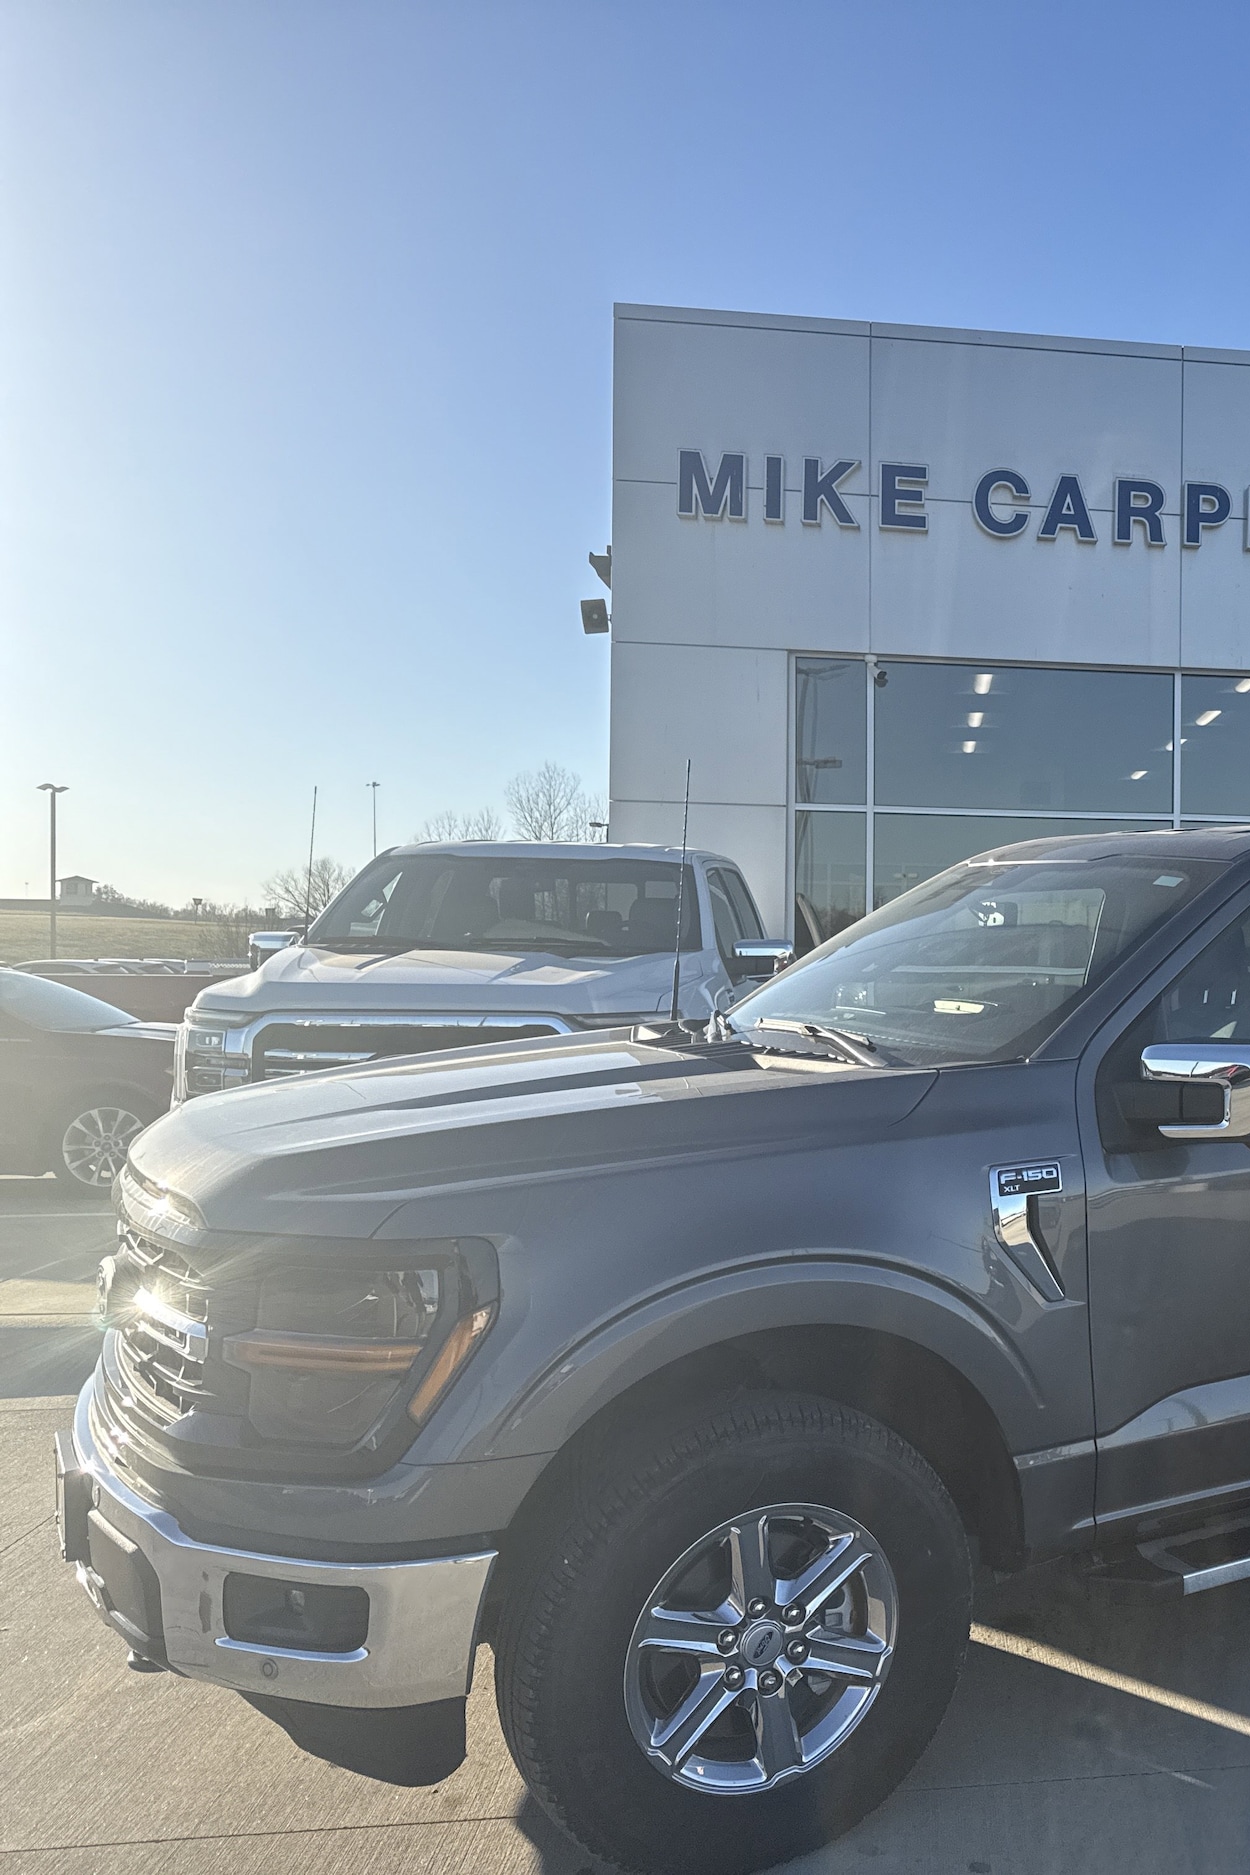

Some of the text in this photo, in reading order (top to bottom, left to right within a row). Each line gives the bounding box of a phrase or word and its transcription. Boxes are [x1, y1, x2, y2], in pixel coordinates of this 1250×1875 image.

[677, 448, 930, 533] MIKE
[1000, 1167, 1058, 1184] F-150
[1003, 1184, 1020, 1192] XLT
